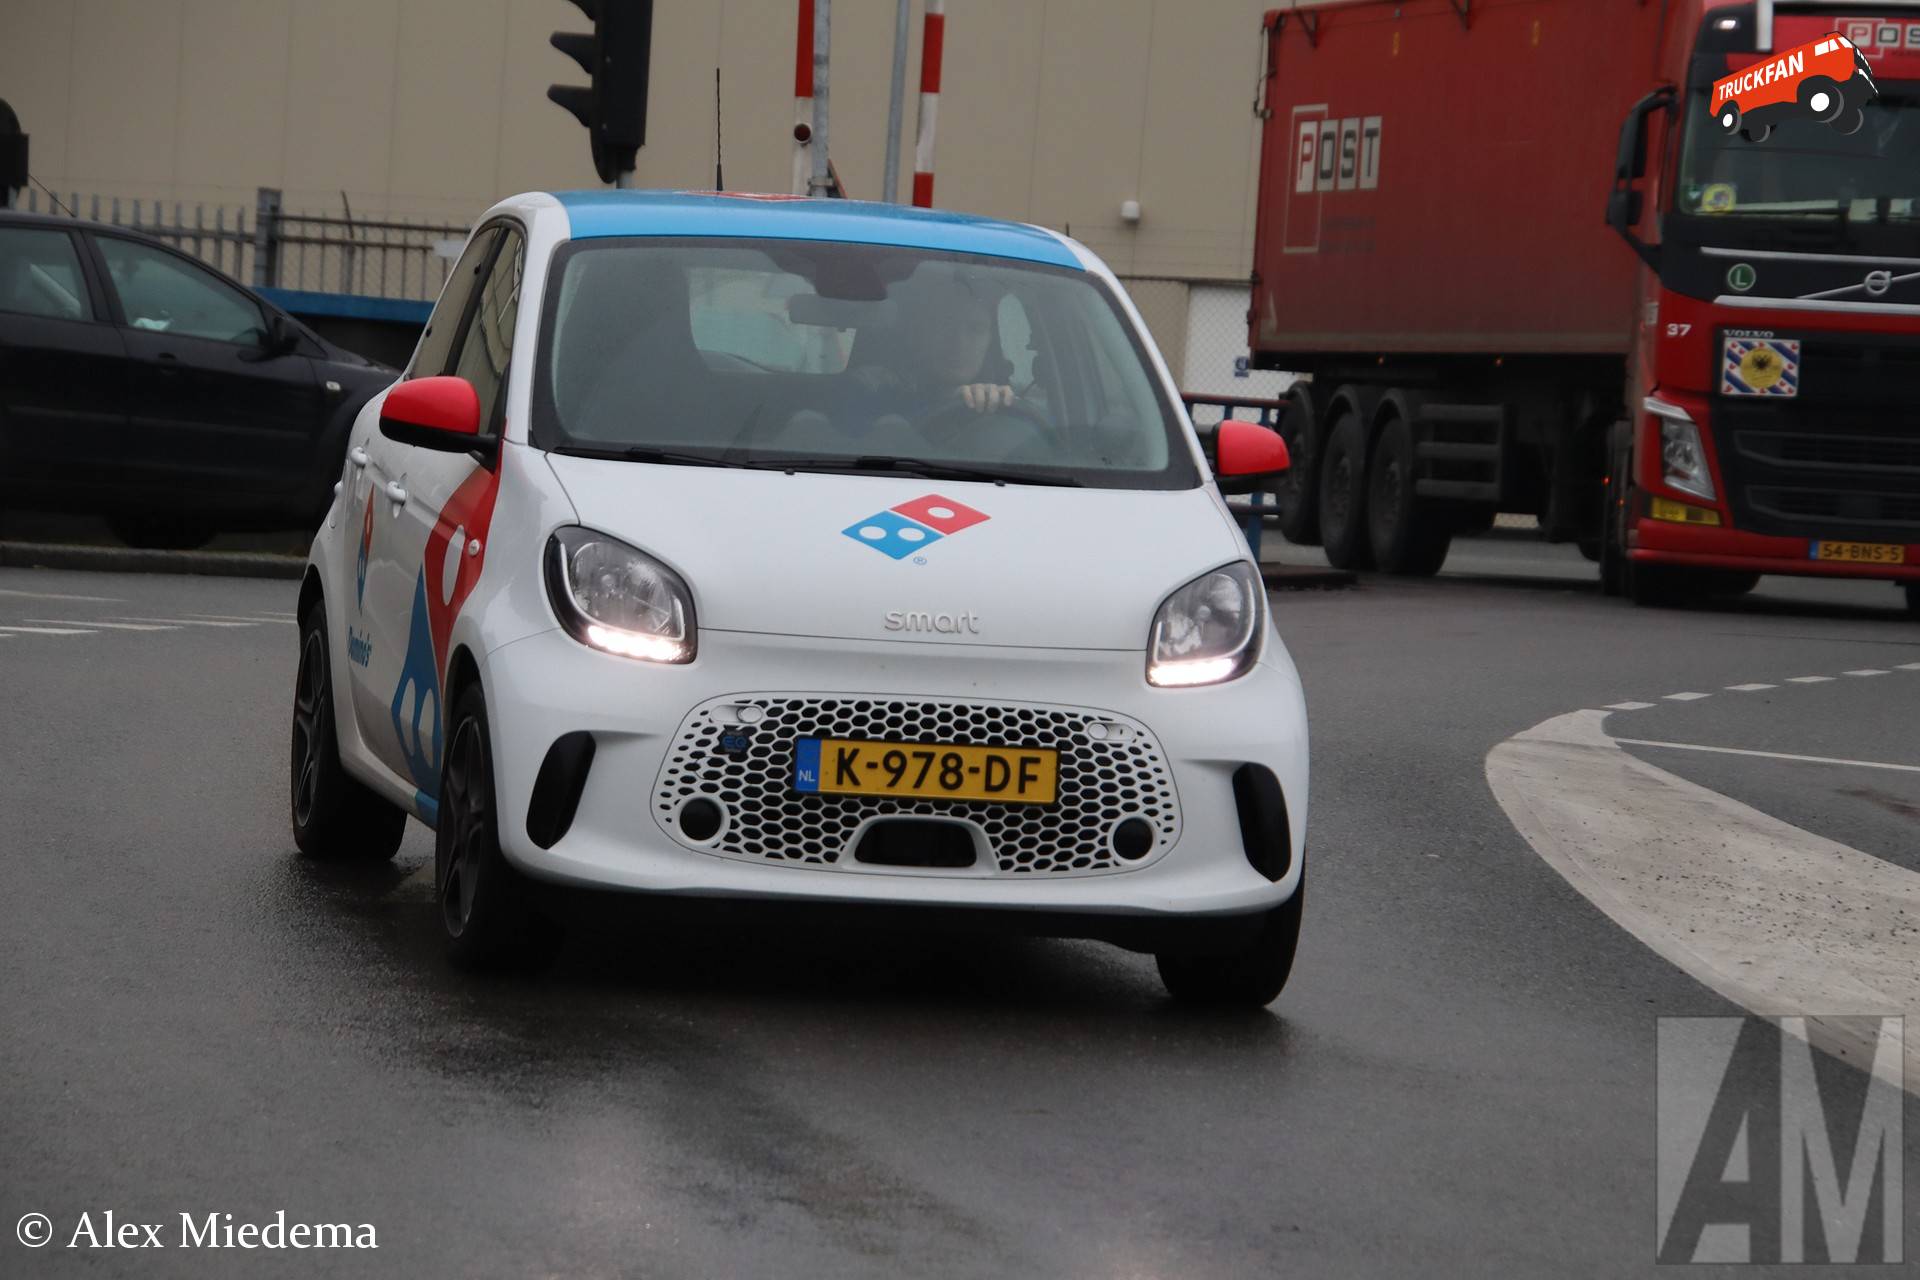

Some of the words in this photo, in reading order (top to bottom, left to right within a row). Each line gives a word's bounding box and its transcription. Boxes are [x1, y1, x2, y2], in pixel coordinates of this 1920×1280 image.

[1298, 123, 1381, 184] POST
[1735, 270, 1748, 286] L
[1667, 324, 1691, 336] 37
[884, 609, 980, 635] smart
[799, 769, 816, 782] NL
[835, 747, 1042, 795] K-978-DF
